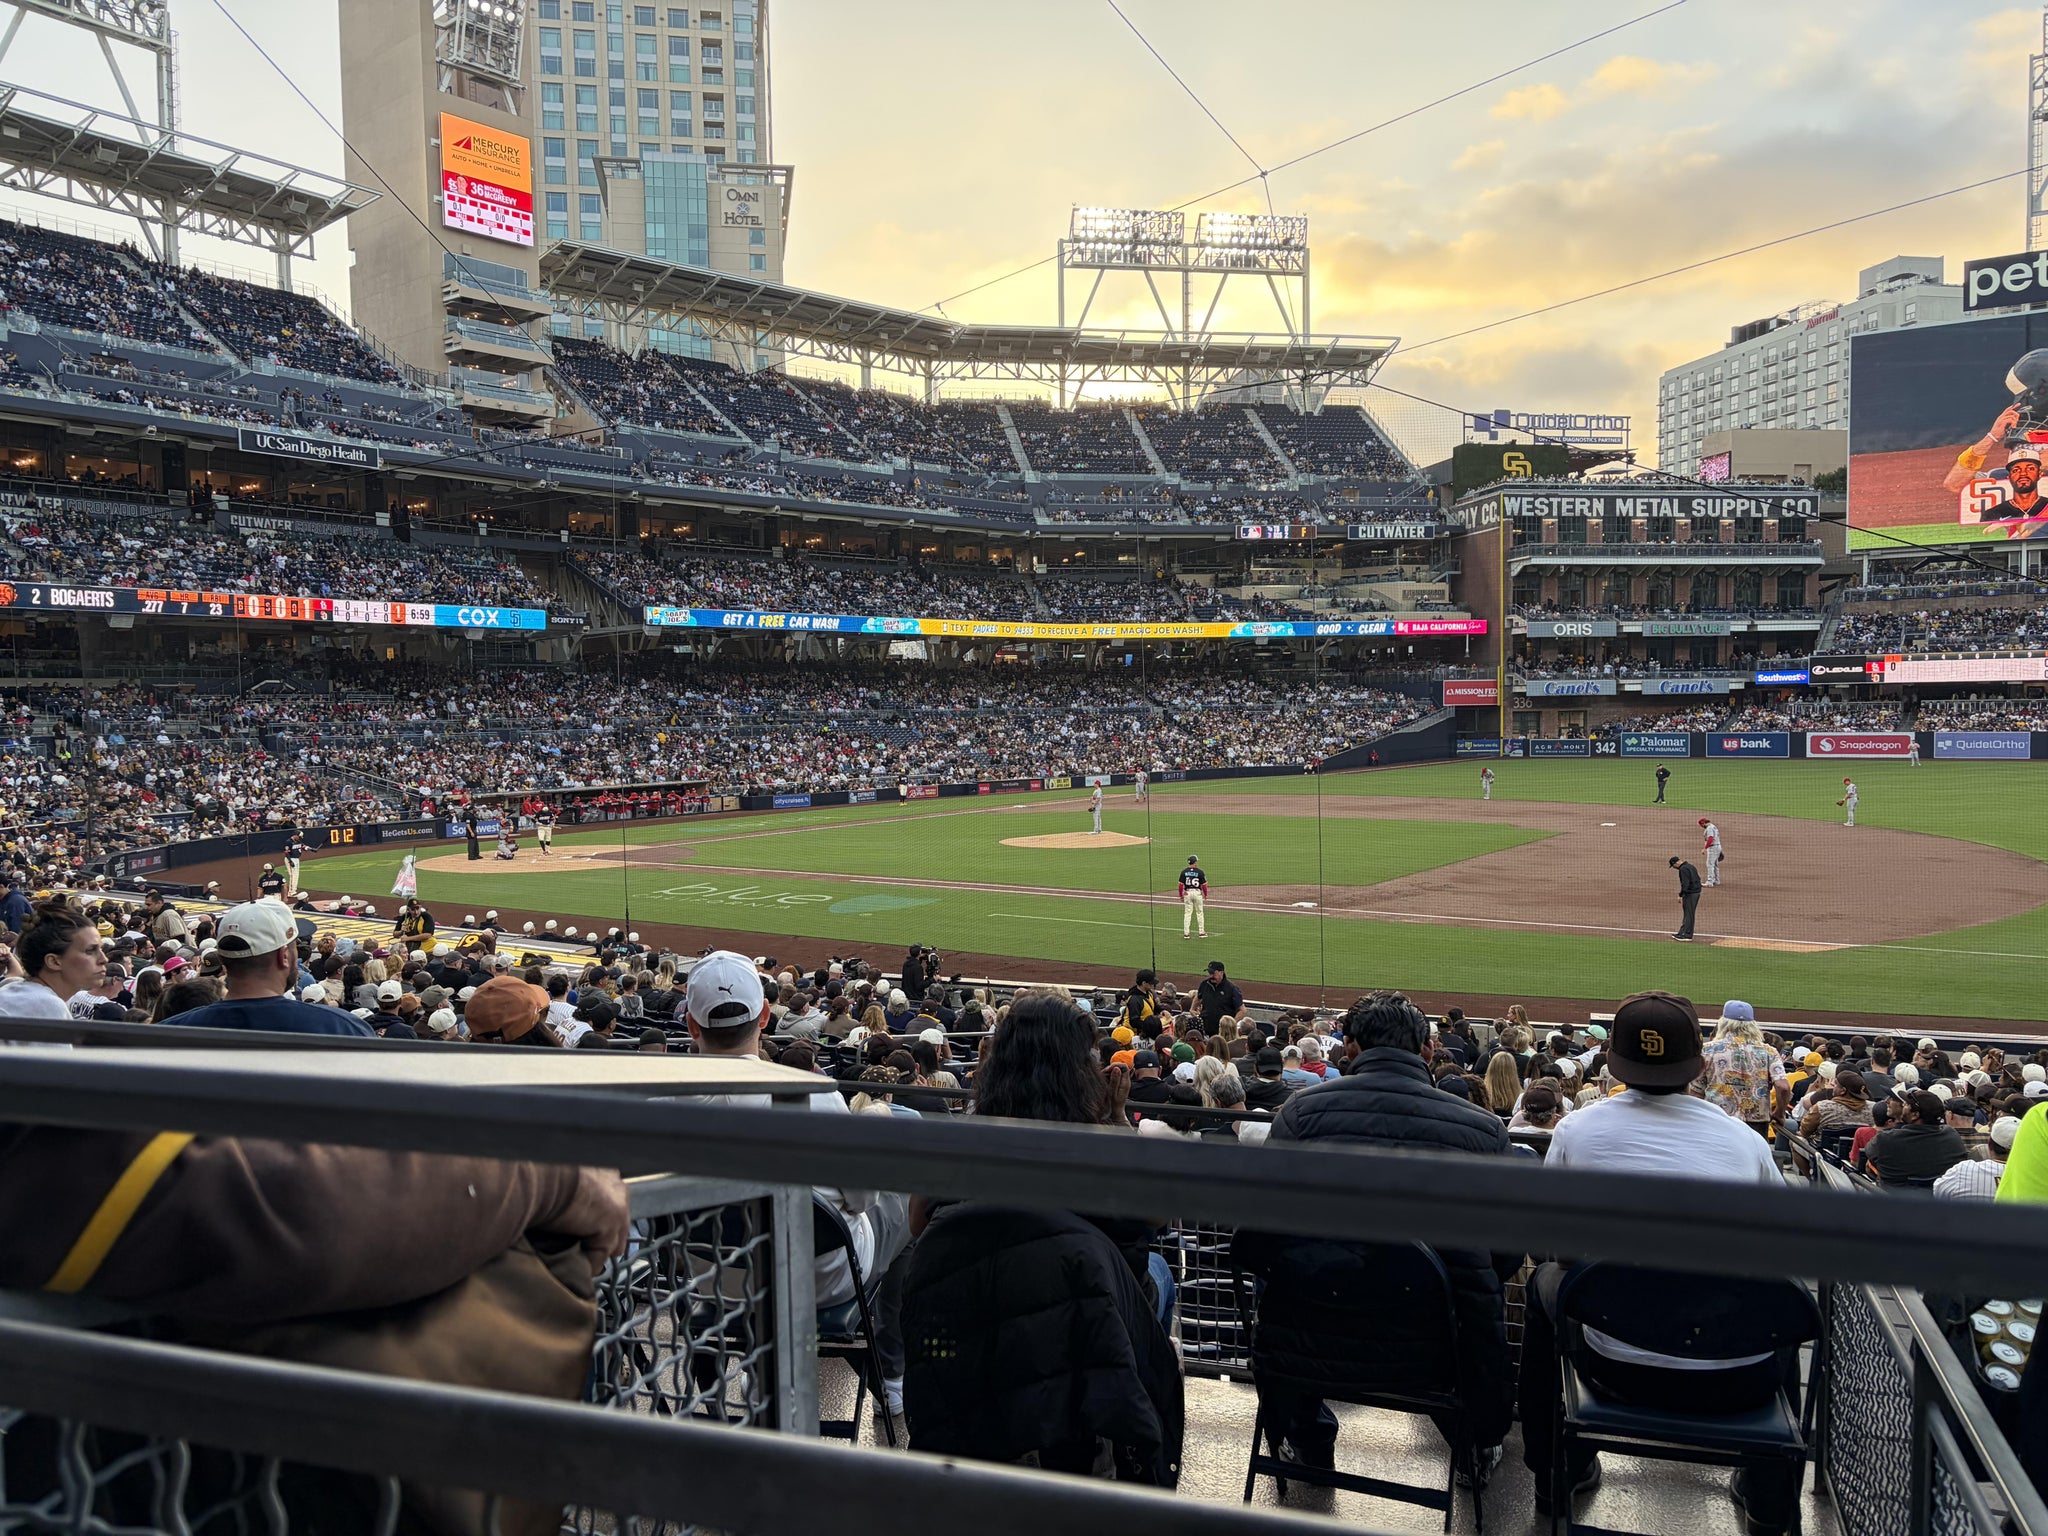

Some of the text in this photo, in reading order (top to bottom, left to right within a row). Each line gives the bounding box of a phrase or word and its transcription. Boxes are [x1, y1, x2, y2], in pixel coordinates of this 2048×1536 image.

[473, 136, 520, 156] MERCURY
[473, 145, 520, 165] INSURANCE
[452, 153, 521, 177] AUTO HOME UMBRELLA
[470, 181, 484, 196] 36
[1515, 413, 1624, 431] QuidelOrtho
[256, 434, 367, 462] UC San Diego Health
[1503, 452, 1533, 477] SD
[66, 498, 138, 517] CORONADO
[1481, 501, 1500, 525] CO.
[1503, 496, 1818, 518] WESTERN METAL SUPPLY CO.
[230, 514, 293, 531] CUTWATER
[1358, 526, 1425, 538] CUTWATER
[31, 588, 115, 607] 2 BOGAERTS
[141, 600, 223, 616] .277 7 23
[248, 595, 260, 617] 0
[275, 596, 287, 618] 0
[411, 608, 430, 620] 6:59
[457, 608, 499, 626] COX
[551, 616, 575, 624] SONY
[723, 613, 840, 629] GET A FREE CAR WASH
[951, 623, 969, 633] TEXT
[972, 624, 998, 634] PADRES
[1001, 625, 1011, 634] TO
[1037, 626, 1047, 635] TO
[1048, 627, 1080, 635] RECEIVE
[1092, 626, 1117, 636] FREE
[1120, 627, 1151, 635] MAGIC
[1153, 627, 1171, 635] JOE
[1173, 626, 1204, 635] WASH!
[1317, 622, 1387, 634] GOOD CLEAN
[1412, 623, 1428, 631] BAJA
[1430, 623, 1468, 631] CALIFORNIA
[1553, 623, 1593, 636] ORIS
[1652, 623, 1725, 634] BIG BULLY TURF
[1758, 673, 1801, 682] Southwest
[1543, 681, 1600, 696] Canel's
[1659, 679, 1714, 694] Canel's
[1512, 697, 1533, 709] 336
[1595, 742, 1616, 754] 342
[1641, 736, 1686, 747] Palomar
[1724, 738, 1771, 749] us bank
[1840, 739, 1902, 752] Snapdragon
[1956, 739, 2026, 750] QuidelOrtho
[382, 827, 433, 837] HeGetsUs.com
[452, 823, 500, 835] Sowest
[653, 882, 833, 904] blue
[458, 934, 480, 947] 19
[1641, 1029, 1664, 1056] SD
